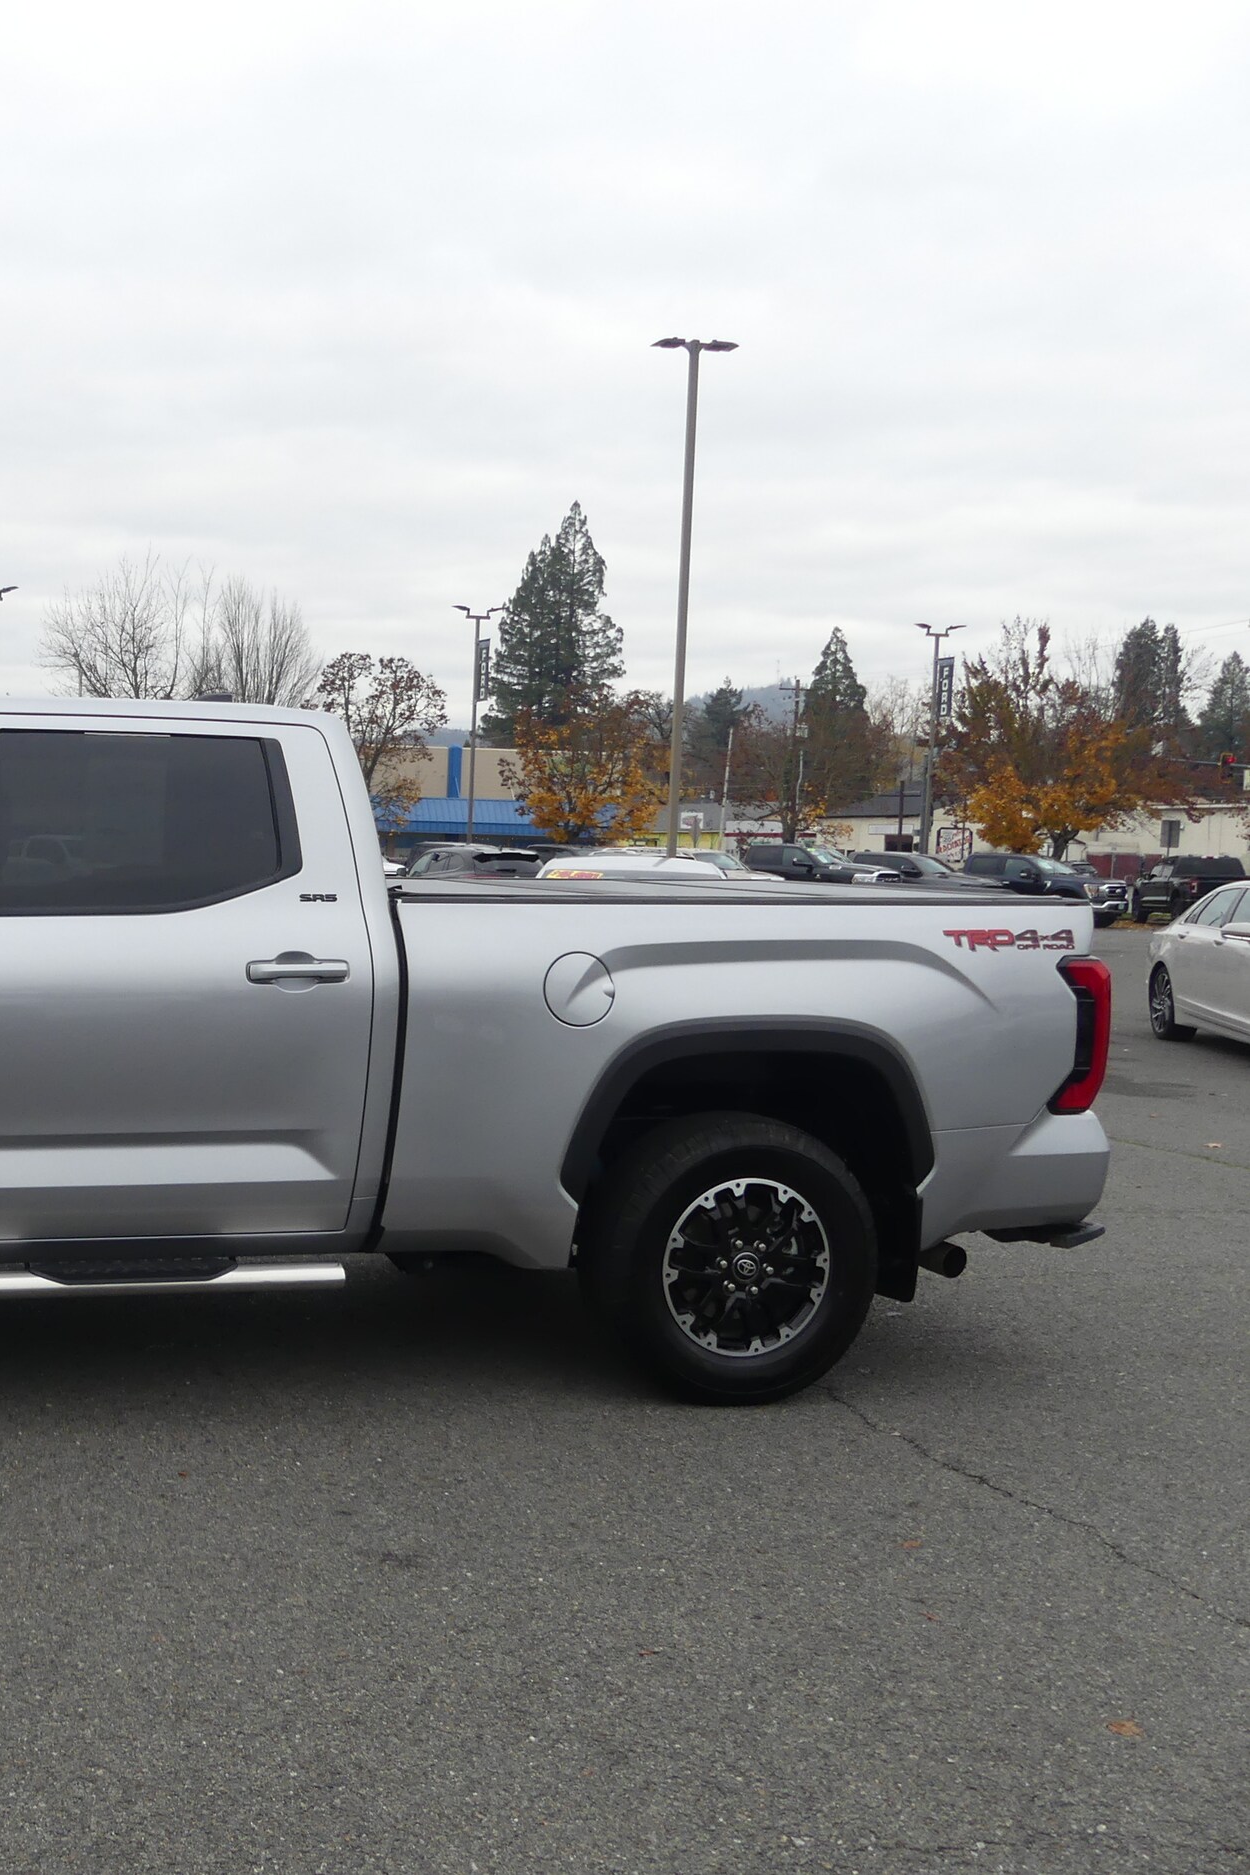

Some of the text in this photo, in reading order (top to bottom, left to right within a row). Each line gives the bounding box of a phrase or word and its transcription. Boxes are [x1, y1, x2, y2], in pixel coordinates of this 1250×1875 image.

[479, 648, 488, 700] FORD
[940, 666, 950, 716] FORD
[299, 893, 338, 903] SR5
[942, 929, 1016, 952] TRD
[1017, 943, 1075, 951] OFF ROAD
